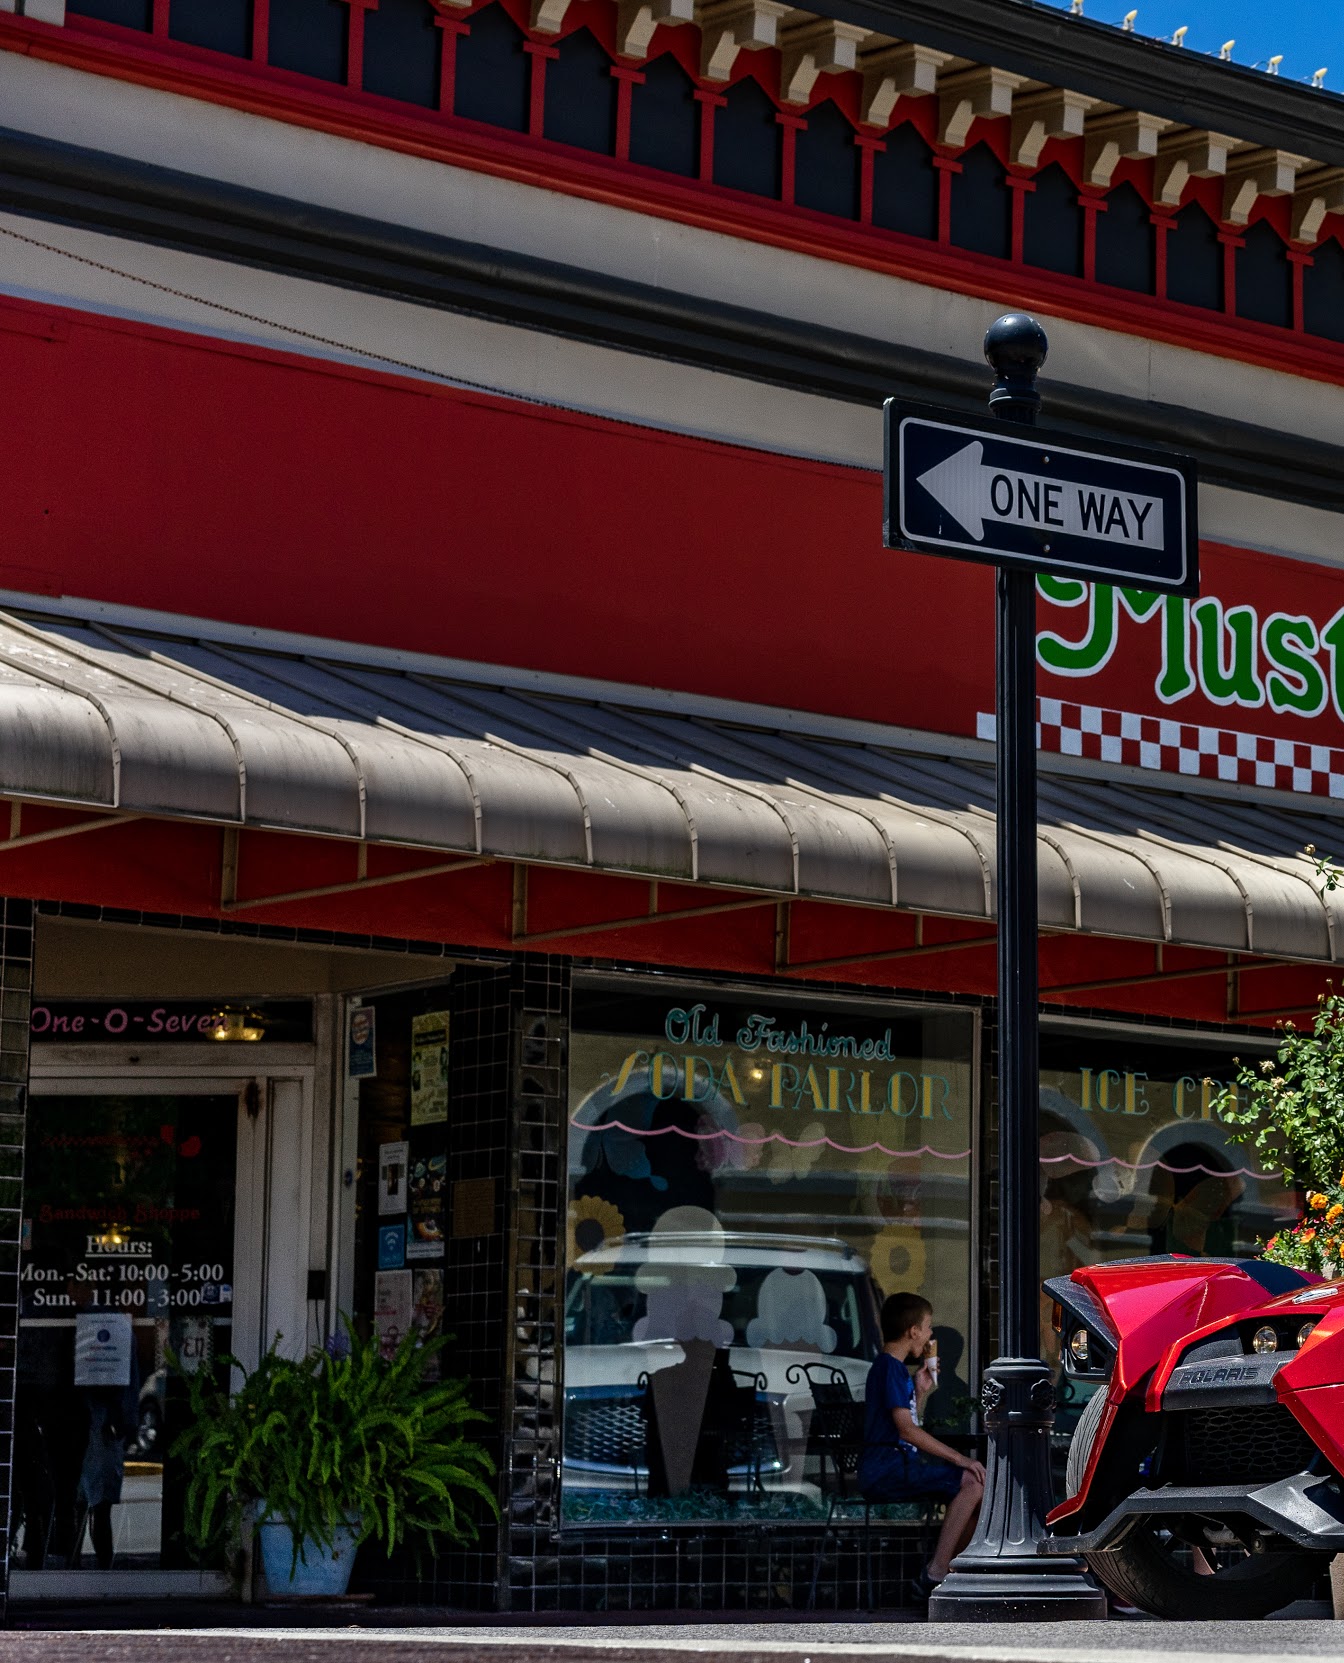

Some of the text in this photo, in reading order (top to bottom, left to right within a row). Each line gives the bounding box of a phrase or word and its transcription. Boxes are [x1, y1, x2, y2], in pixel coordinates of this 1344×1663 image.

[990, 474, 1153, 541] ONE WAY
[665, 1003, 896, 1061] Old Fashioned
[599, 1049, 952, 1120] SODA PARLOR
[1079, 1067, 1150, 1115] ICE
[33, 1288, 77, 1307] Sun.
[1179, 1367, 1259, 1384] POLARIS
